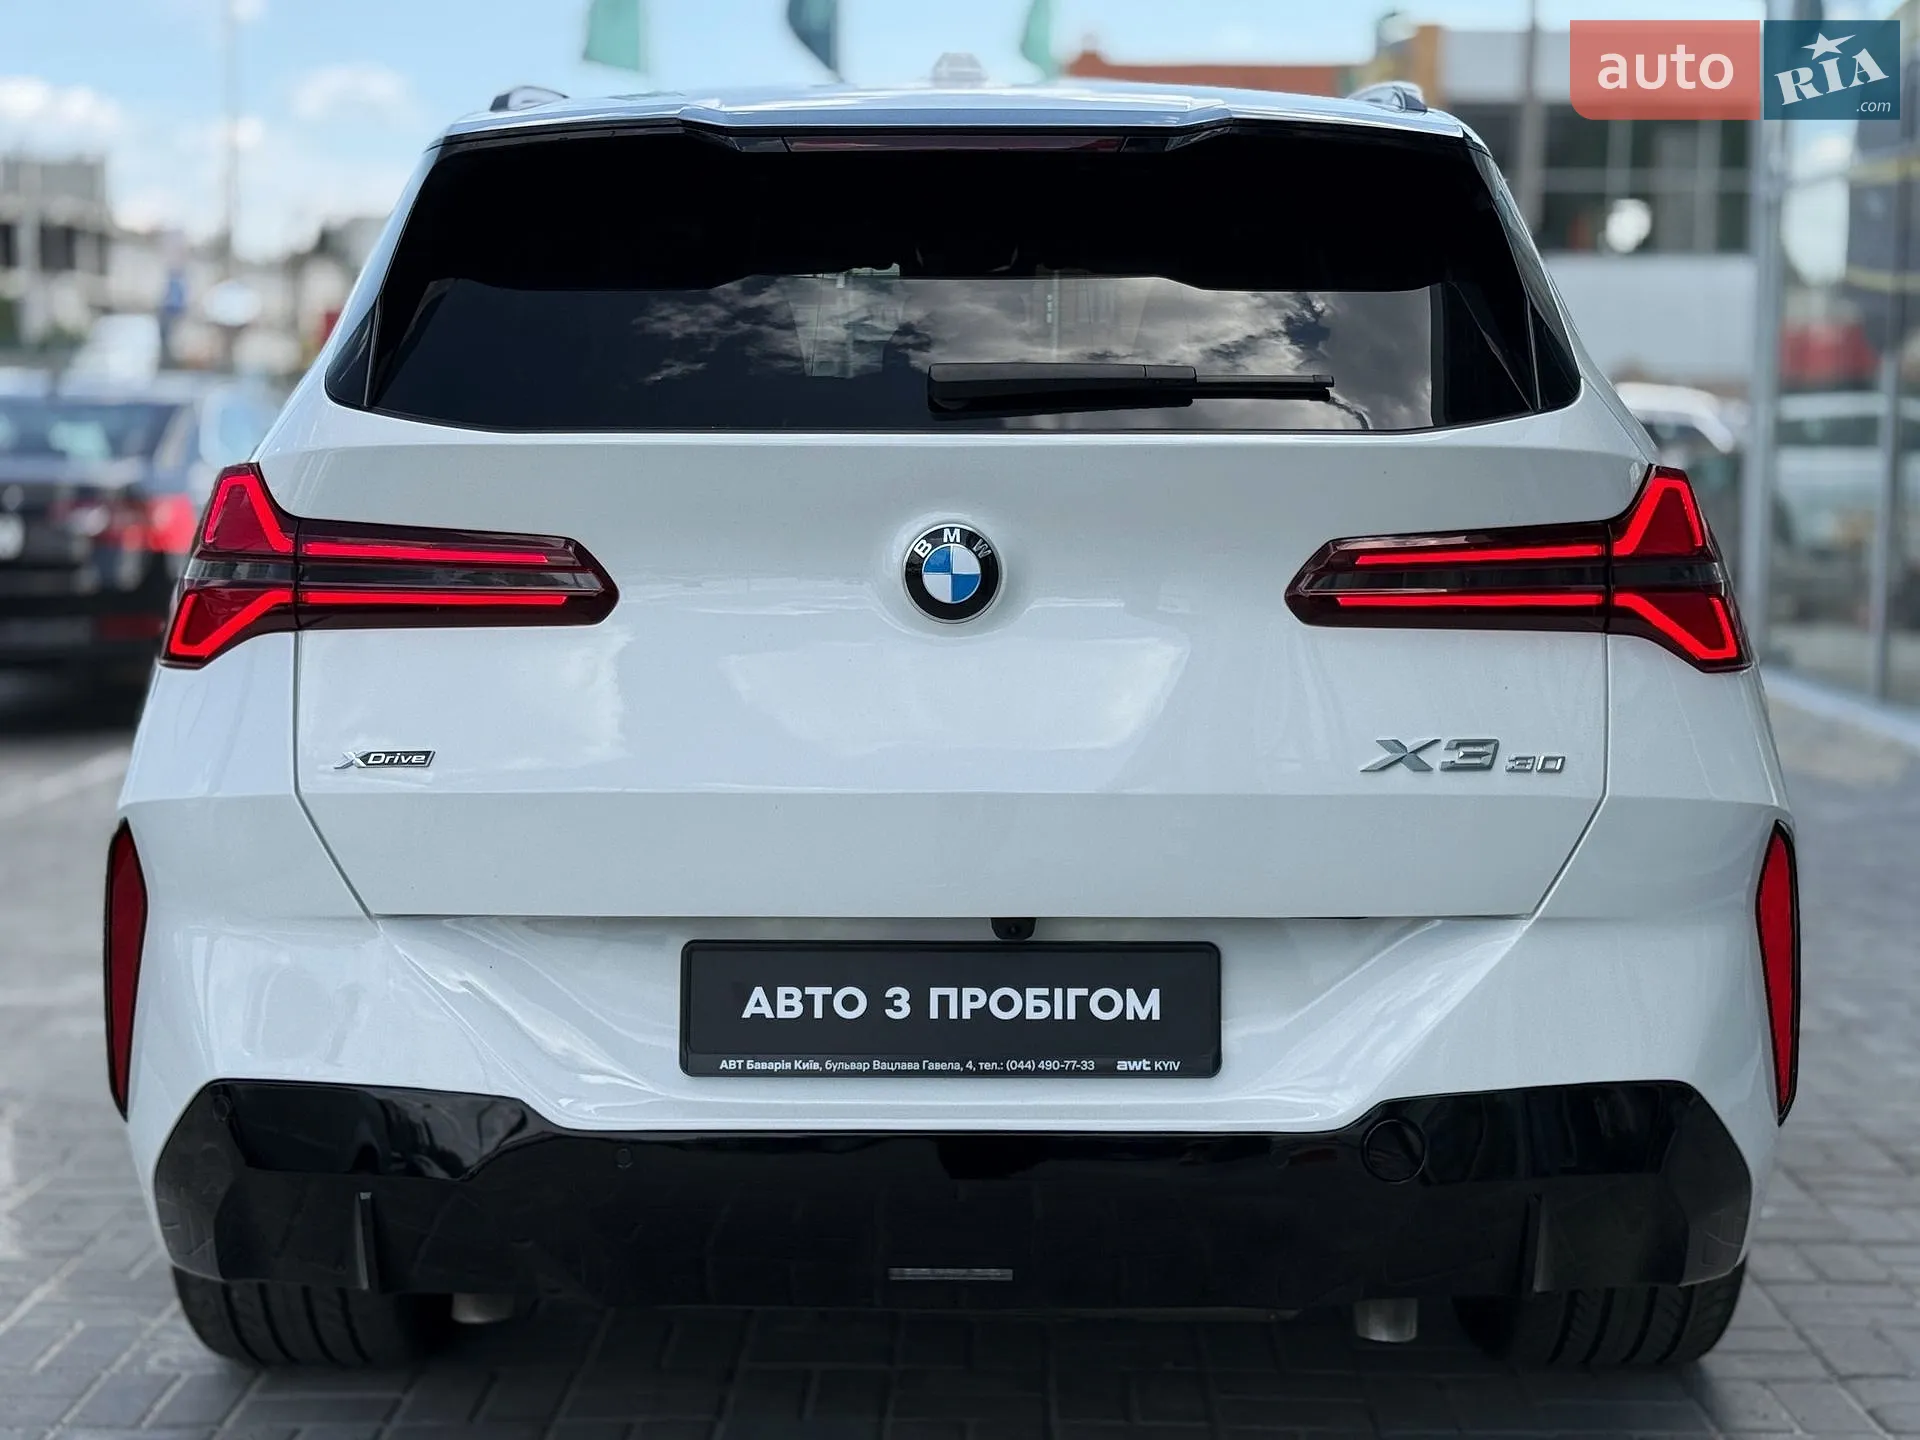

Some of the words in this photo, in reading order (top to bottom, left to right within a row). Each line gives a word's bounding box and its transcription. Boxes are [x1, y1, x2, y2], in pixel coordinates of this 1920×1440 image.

[913, 527, 992, 559] BMW
[1359, 737, 1500, 772] X3
[1505, 755, 1566, 773] 30
[741, 986, 868, 1020] АВТО
[929, 987, 1161, 1021] ПРОБІГОМ
[719, 1059, 745, 1070] АВТ
[746, 1059, 791, 1072] Баварія
[794, 1059, 823, 1072] Київ,
[825, 1059, 870, 1072] бульвар
[873, 1059, 920, 1072] Вацлава
[922, 1059, 964, 1072] Гавела,
[966, 1060, 976, 1072] 4,
[978, 1061, 1004, 1071] тел.:
[1006, 1059, 1036, 1072] (044)
[1038, 1060, 1095, 1071] 490-77-33
[1117, 1058, 1152, 1071] awt
[1155, 1060, 1181, 1071] KYIV
